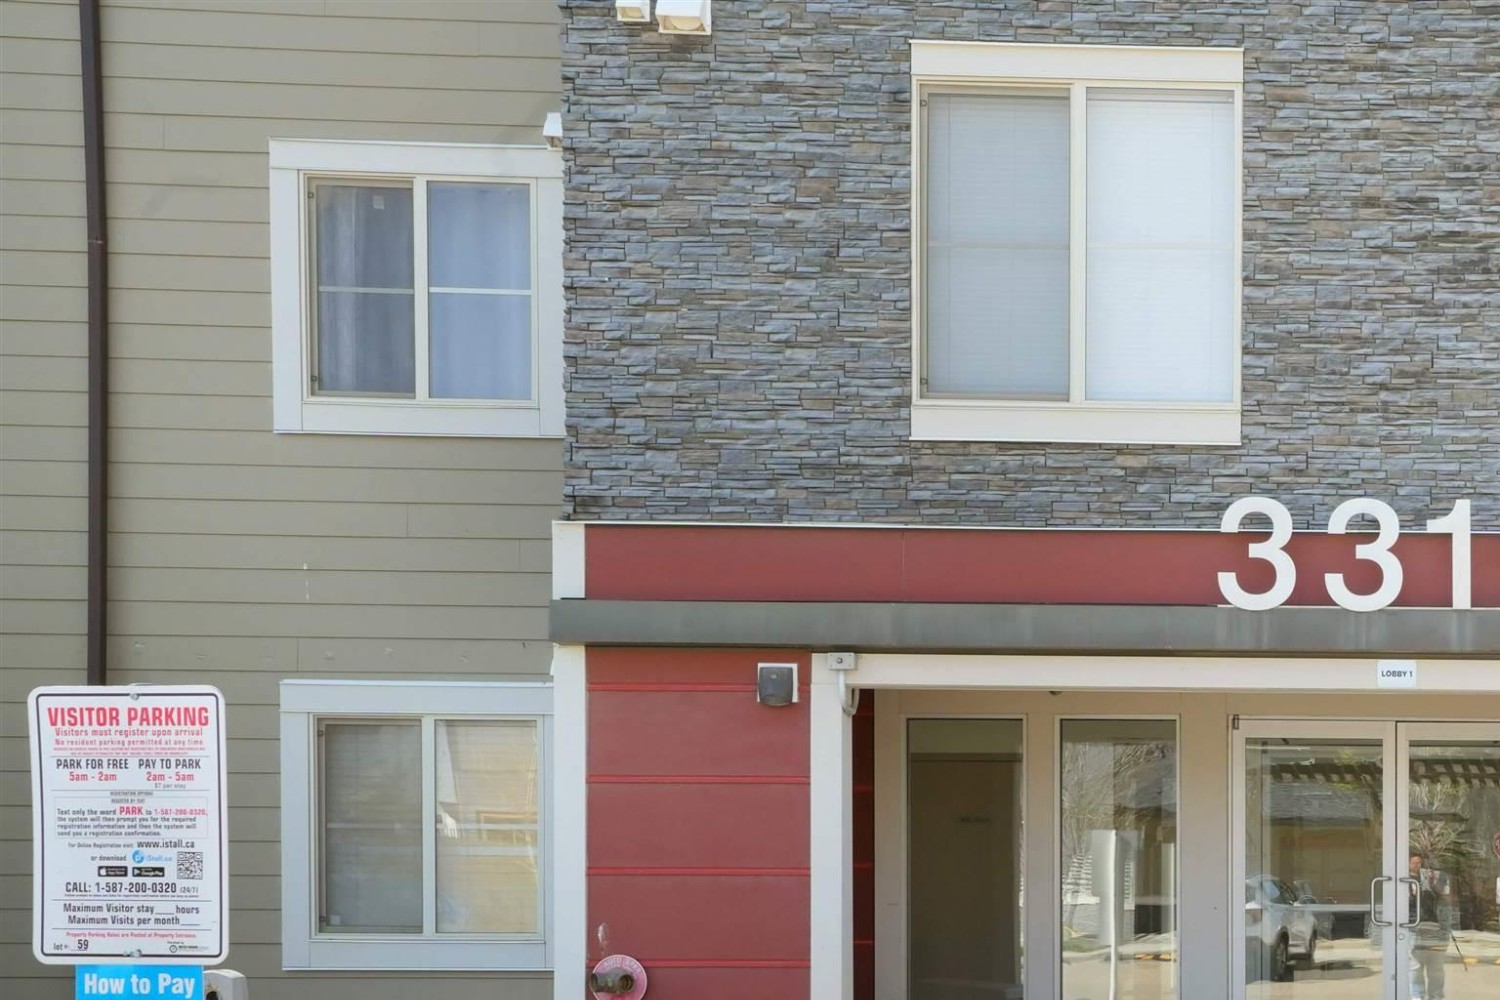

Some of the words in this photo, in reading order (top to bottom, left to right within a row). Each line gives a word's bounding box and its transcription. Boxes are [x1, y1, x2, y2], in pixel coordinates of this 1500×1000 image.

[47, 707, 120, 726] VISITOR
[128, 707, 209, 726] PARKING
[114, 728, 148, 738] register
[152, 730, 172, 738] upon
[175, 727, 202, 736] arrival
[99, 739, 125, 747] parking
[56, 759, 82, 769] PARK
[86, 759, 103, 769] FOR
[107, 759, 129, 769] FREE
[138, 759, 156, 769] PAY
[160, 759, 171, 769] TO
[175, 759, 201, 769] PARK
[70, 772, 88, 781] 5am
[98, 772, 117, 781] 2am
[146, 772, 165, 781] 2am
[175, 772, 194, 781] 5am
[120, 806, 143, 815] PARK
[137, 839, 194, 848] www.istall.ca
[66, 882, 91, 893] CALL:
[95, 882, 176, 893] 1-587-200-0320
[64, 903, 103, 912] Maximum
[106, 904, 134, 912] Visitor
[137, 905, 154, 915] stay
[176, 905, 200, 914] hours
[68, 915, 108, 924] Maximum
[111, 915, 134, 924] Visits
[154, 916, 180, 925] month
[78, 939, 88, 950] 59
[84, 973, 125, 994] How
[131, 974, 151, 994] to
[158, 973, 195, 999] Pay
